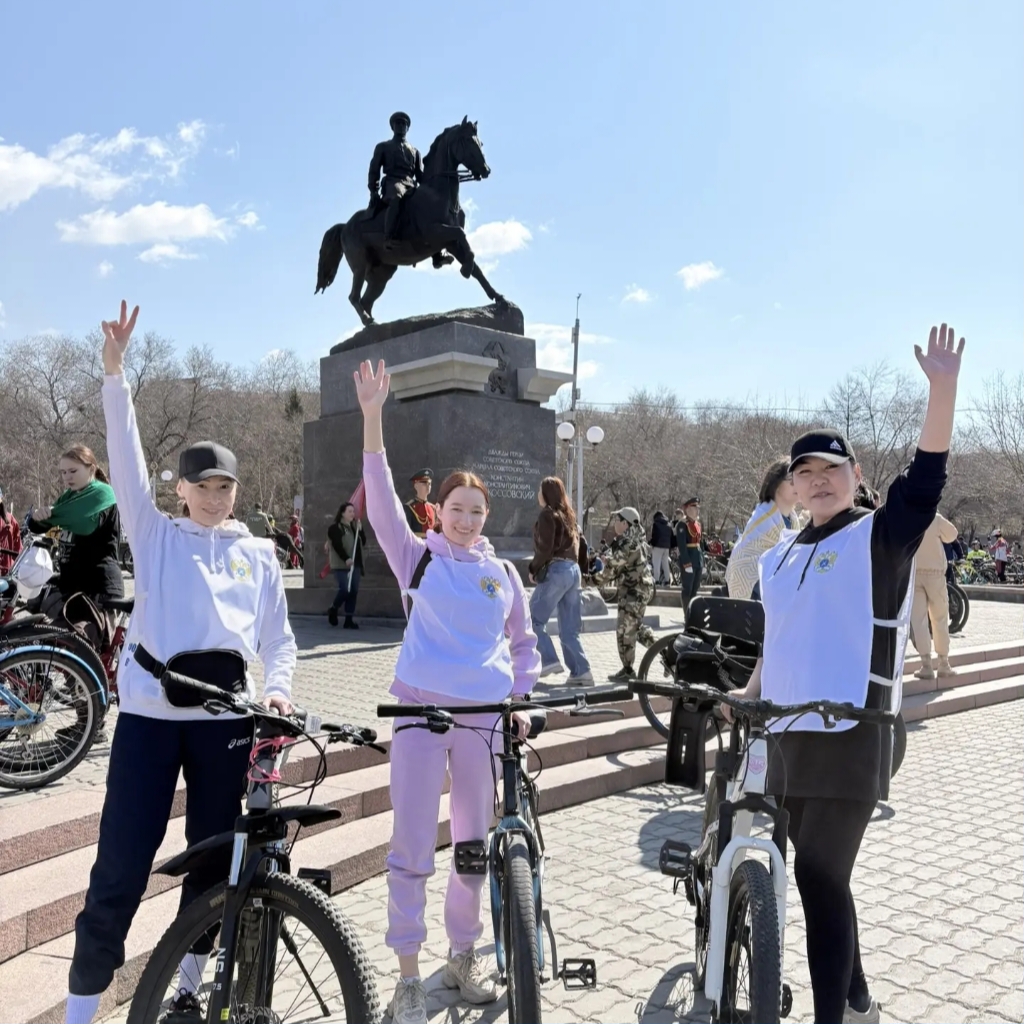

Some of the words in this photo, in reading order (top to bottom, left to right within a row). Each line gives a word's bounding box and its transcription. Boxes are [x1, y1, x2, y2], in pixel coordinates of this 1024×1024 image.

[483, 456, 512, 464] СОВЕТСКОГО
[494, 465, 523, 473] СОВЕТСКОГО
[488, 488, 535, 499] КОССОВСКИЙ
